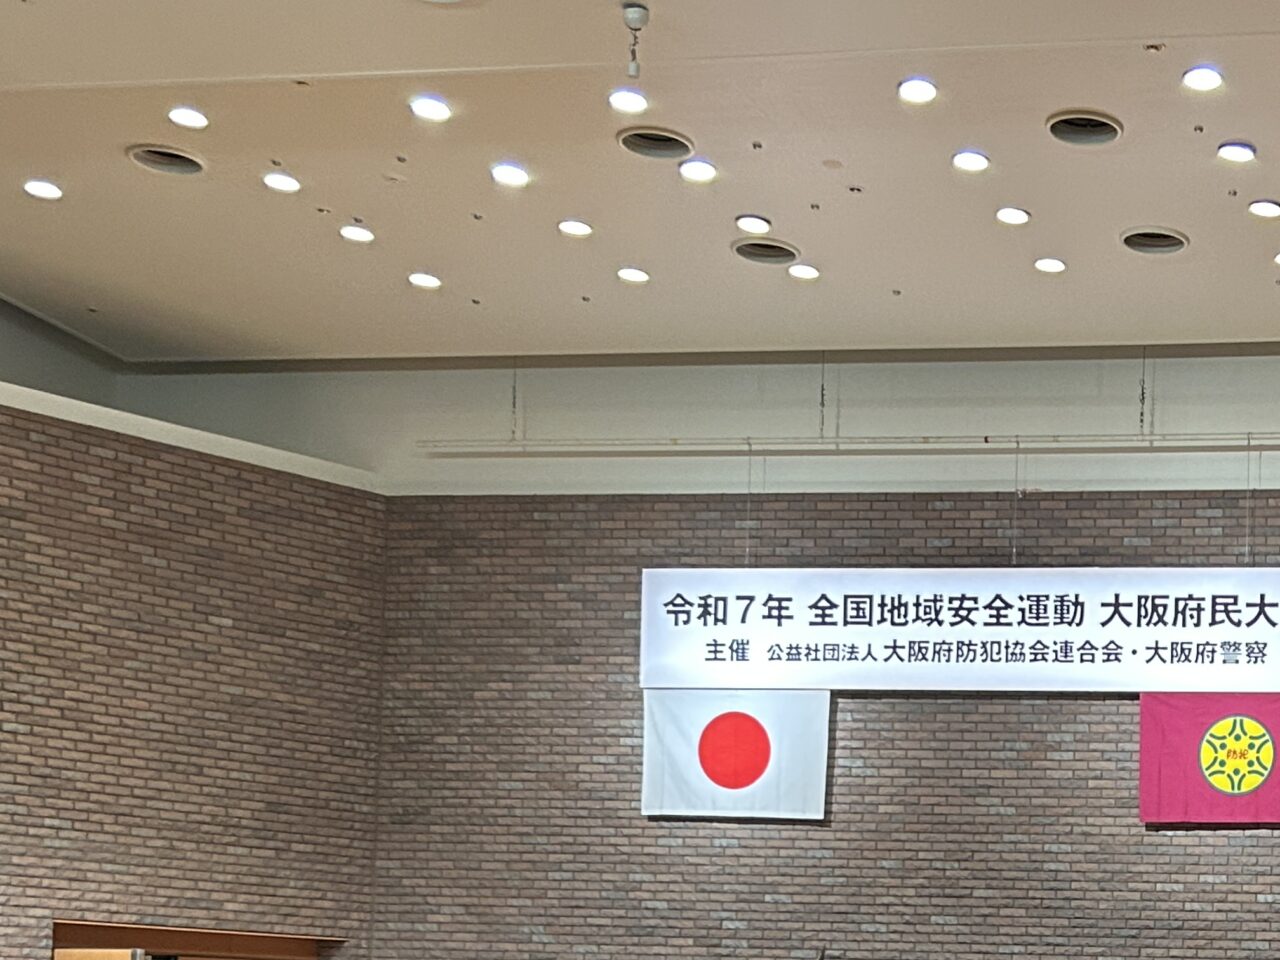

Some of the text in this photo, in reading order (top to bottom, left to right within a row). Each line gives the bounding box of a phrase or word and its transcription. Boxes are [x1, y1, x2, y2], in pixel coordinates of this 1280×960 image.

[663, 593, 794, 627] 令和7年
[808, 593, 1086, 627] 全国地域安全運動
[704, 638, 750, 662] 主催
